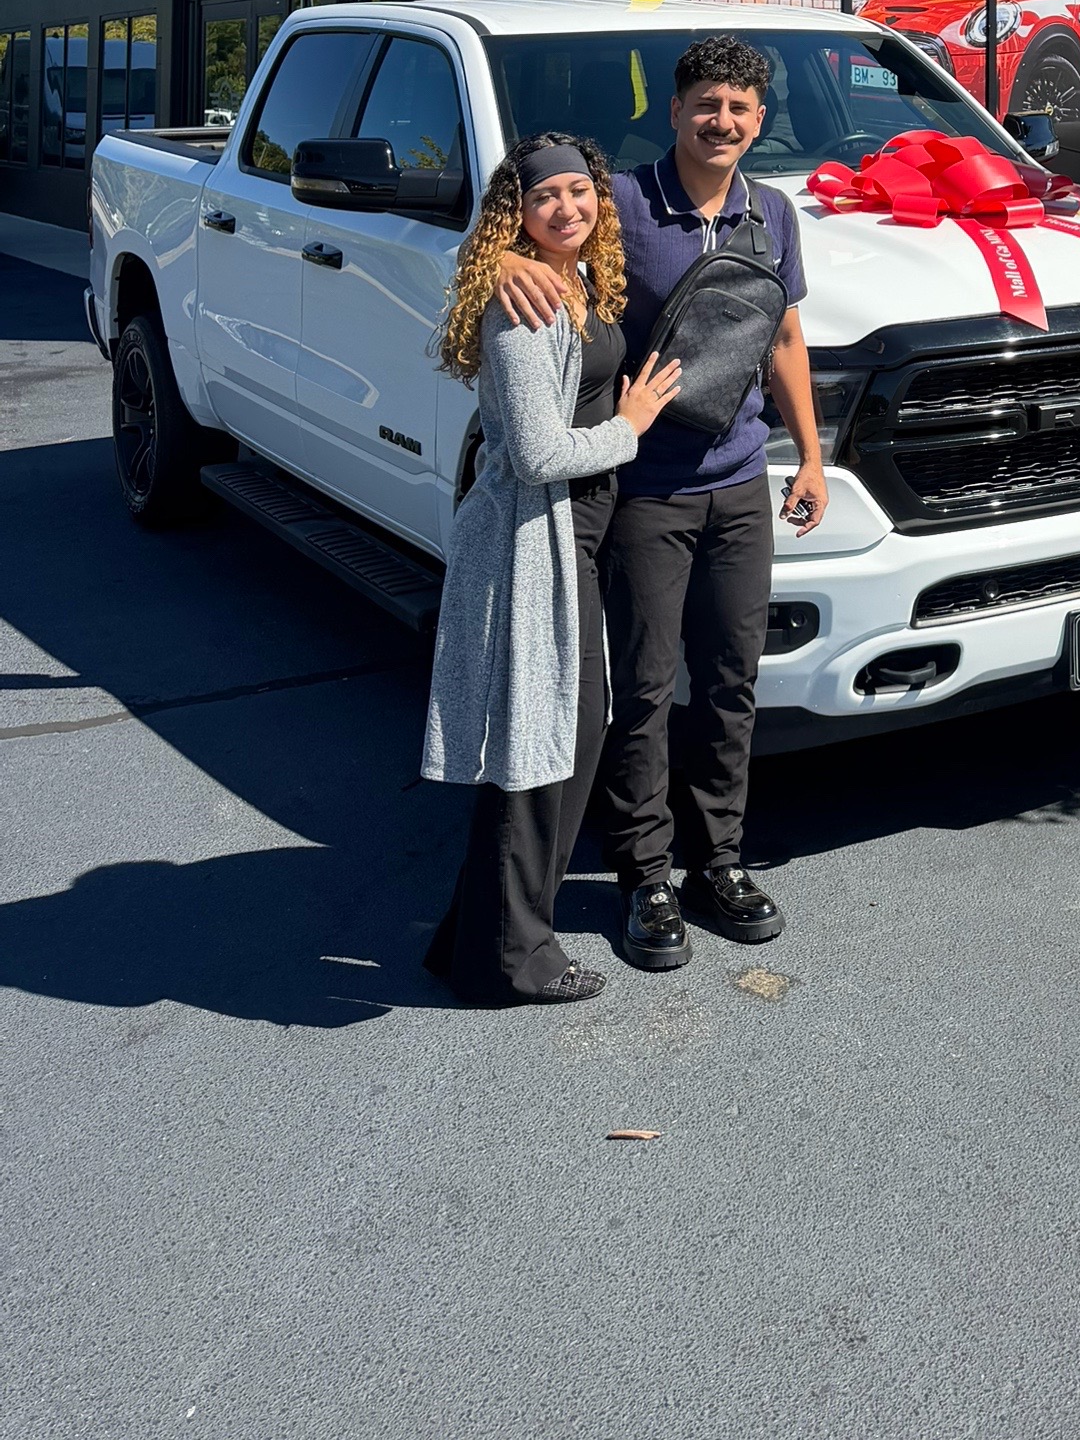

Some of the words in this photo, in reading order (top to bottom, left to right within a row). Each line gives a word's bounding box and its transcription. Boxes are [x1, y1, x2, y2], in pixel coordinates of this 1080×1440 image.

[882, 70, 897, 87] 93
[999, 257, 1018, 270] of
[1004, 271, 1028, 298] Mall
[379, 424, 423, 457] RAM
